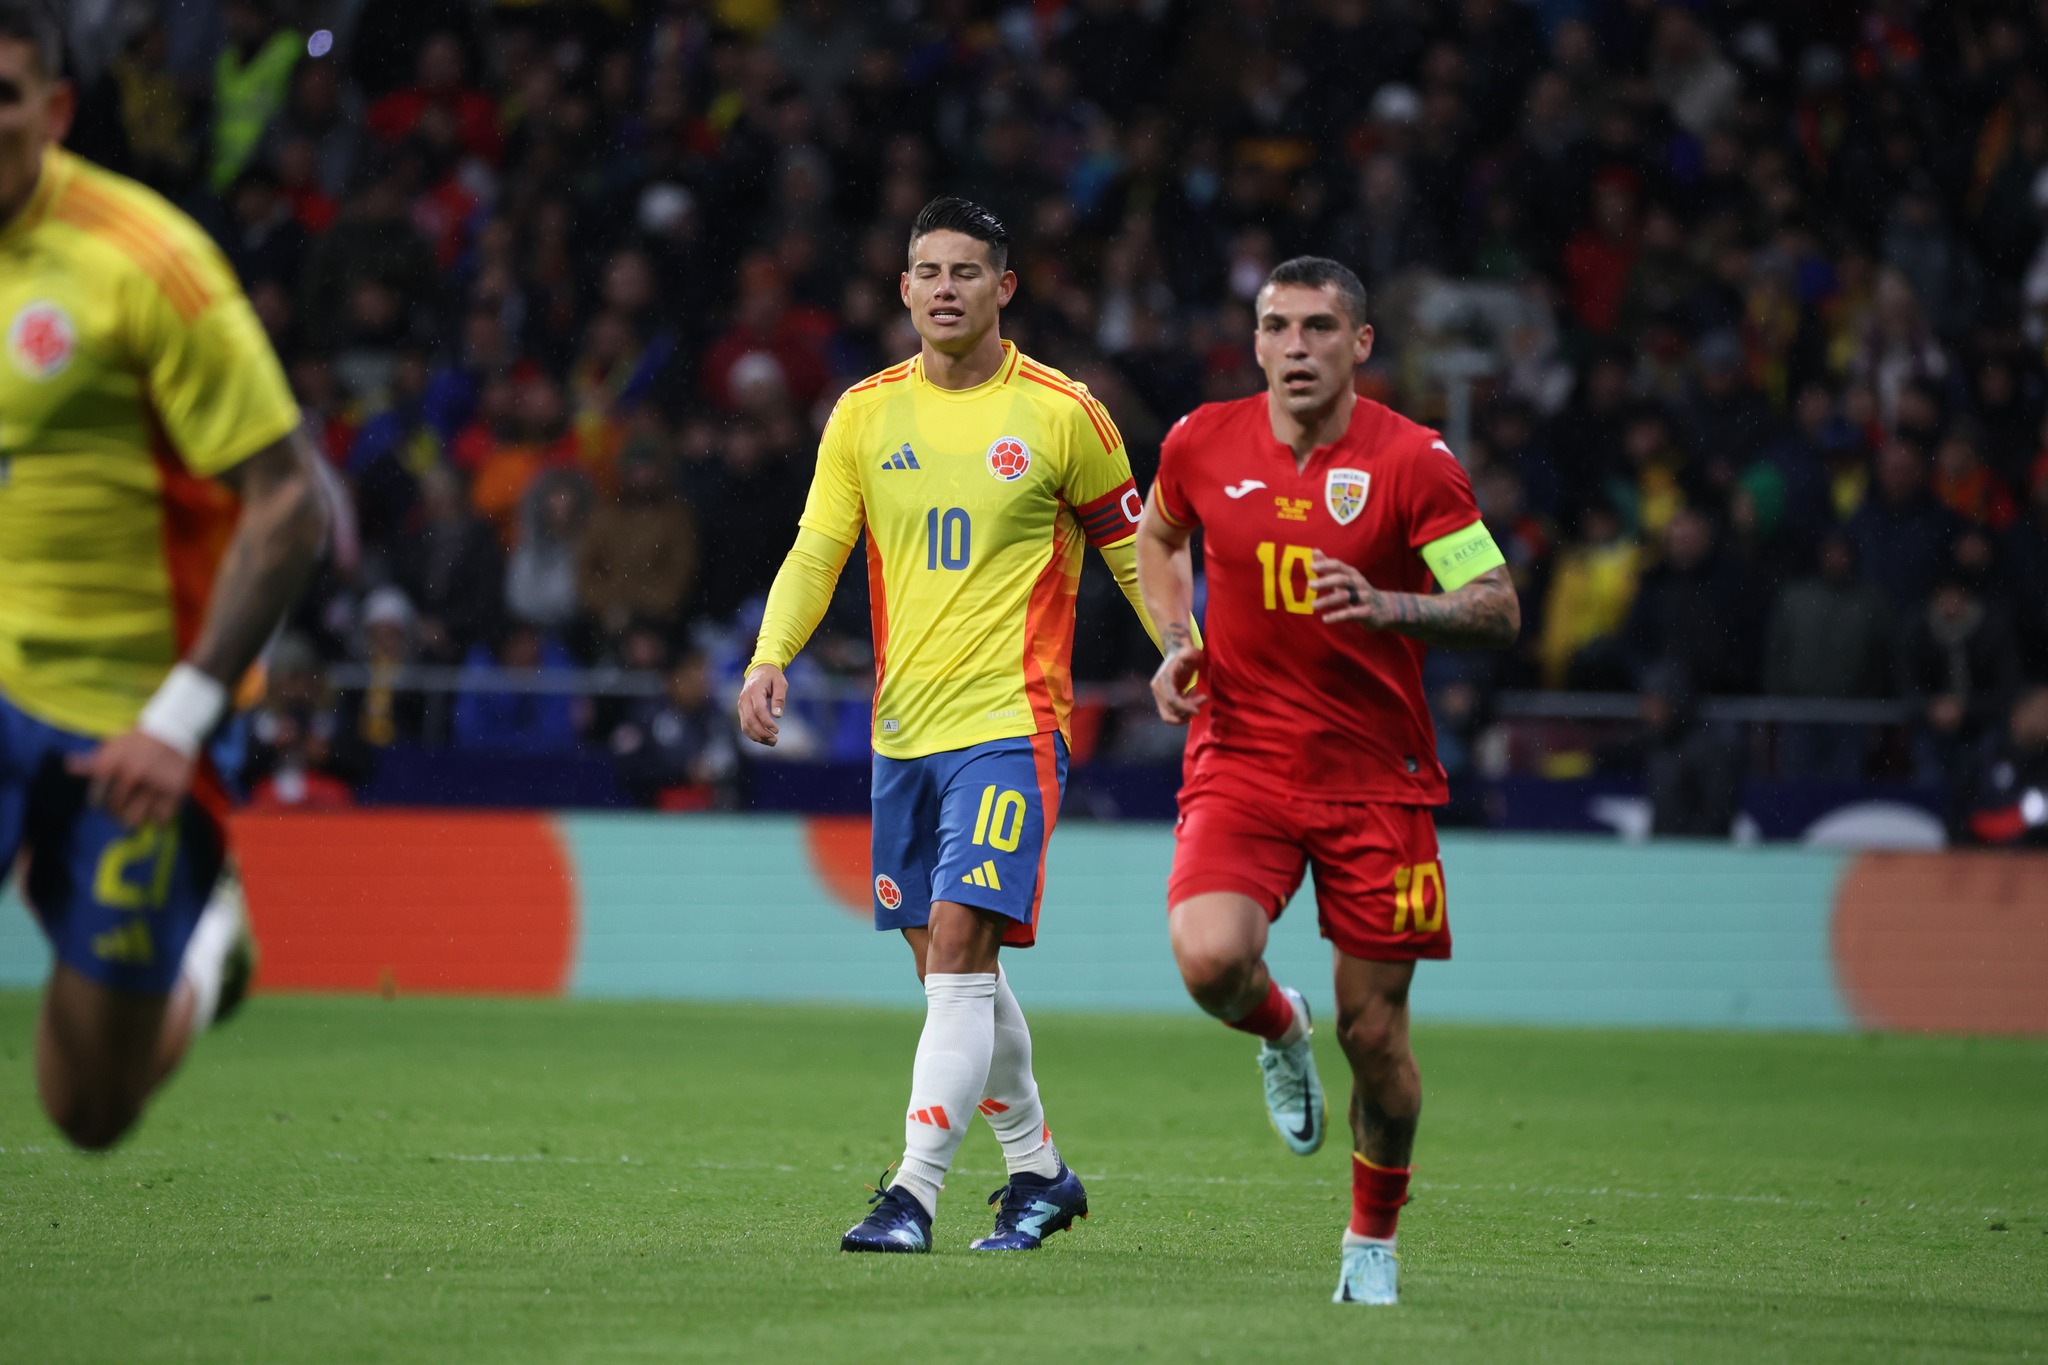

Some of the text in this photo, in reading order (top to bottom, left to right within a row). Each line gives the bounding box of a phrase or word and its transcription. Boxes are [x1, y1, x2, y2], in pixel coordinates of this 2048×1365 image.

[928, 507, 971, 570] 10
[1121, 488, 1144, 523] C
[1256, 541, 1318, 614] 10
[974, 785, 1027, 852] 10
[1393, 862, 1444, 932] 10
